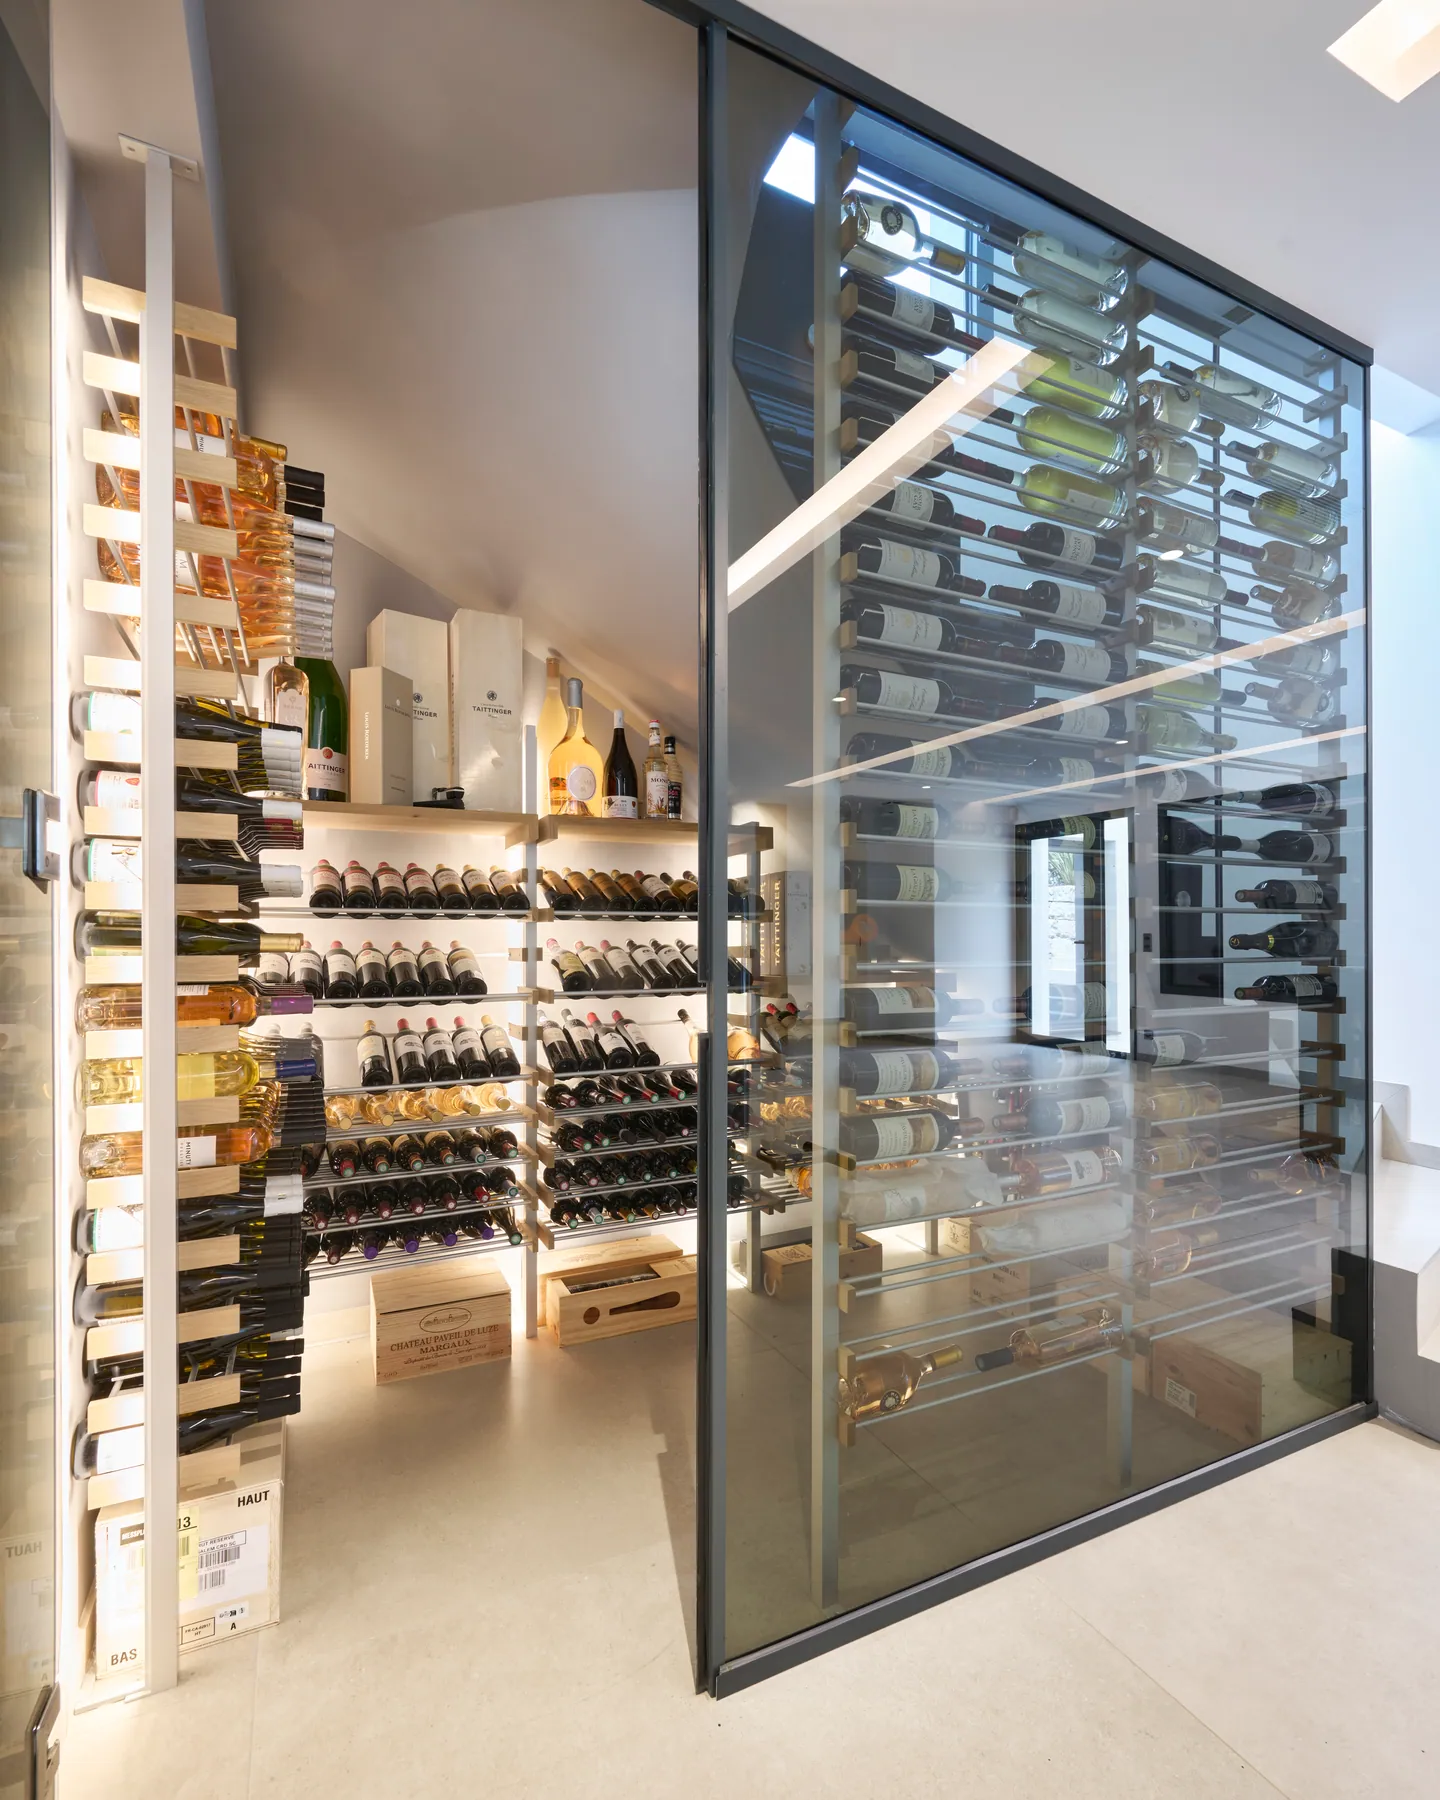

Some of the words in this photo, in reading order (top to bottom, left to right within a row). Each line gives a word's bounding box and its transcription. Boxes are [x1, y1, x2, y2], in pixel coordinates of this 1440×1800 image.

[413, 709, 438, 718] TINGER
[472, 705, 512, 715] TAITTINGER
[307, 763, 345, 774] AITTINGER
[390, 1336, 432, 1351] CHATEAU
[434, 1332, 463, 1343] PAVEIL
[464, 1328, 476, 1338] DE
[477, 1324, 500, 1334] LUZE
[420, 1339, 472, 1355] MARGAUX
[237, 1490, 270, 1507] HAUT
[230, 1622, 237, 1630] A
[110, 1649, 137, 1666] BAS
